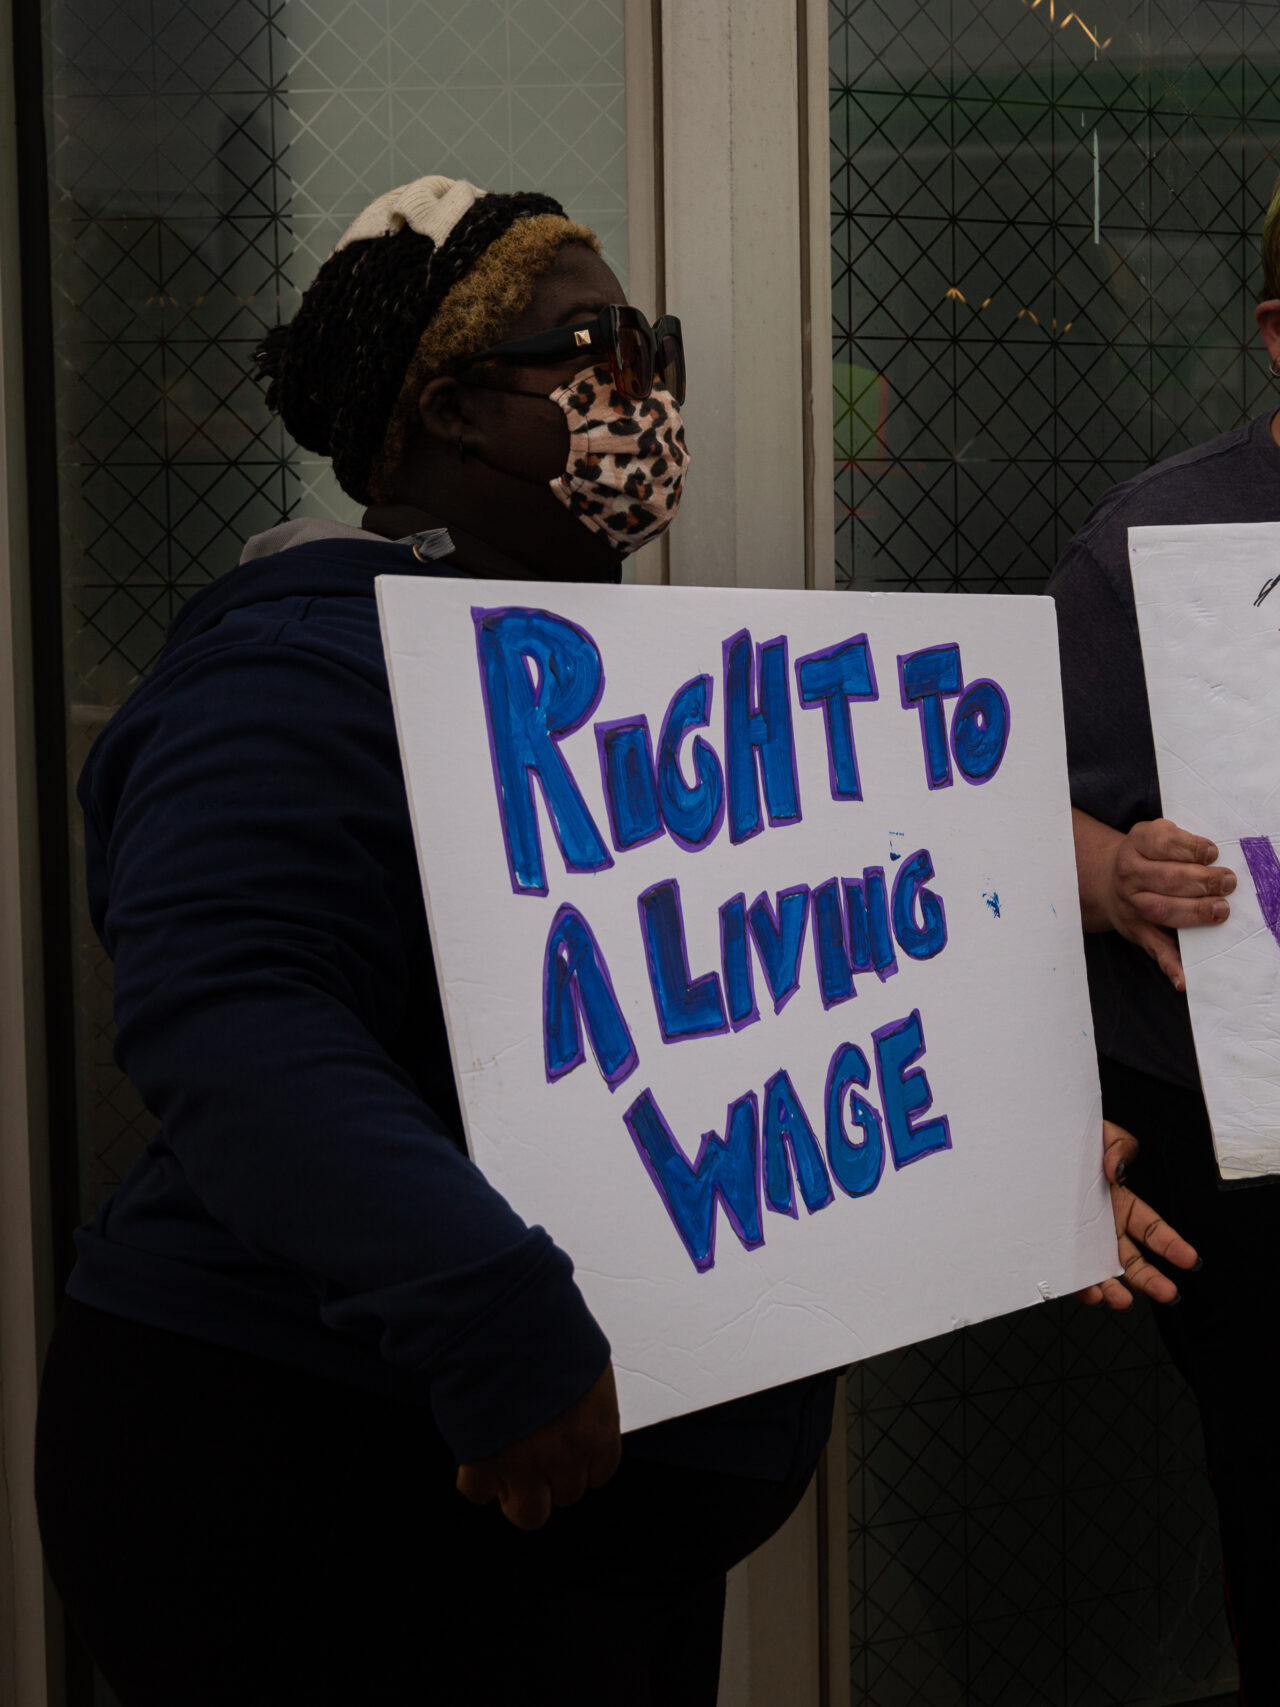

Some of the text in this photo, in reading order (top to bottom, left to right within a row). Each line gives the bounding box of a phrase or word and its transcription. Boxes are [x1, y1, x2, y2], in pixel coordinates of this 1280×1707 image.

[471, 605, 879, 897] RIGHT
[541, 848, 949, 1093] A LIVING
[623, 1008, 953, 1273] WAGE
